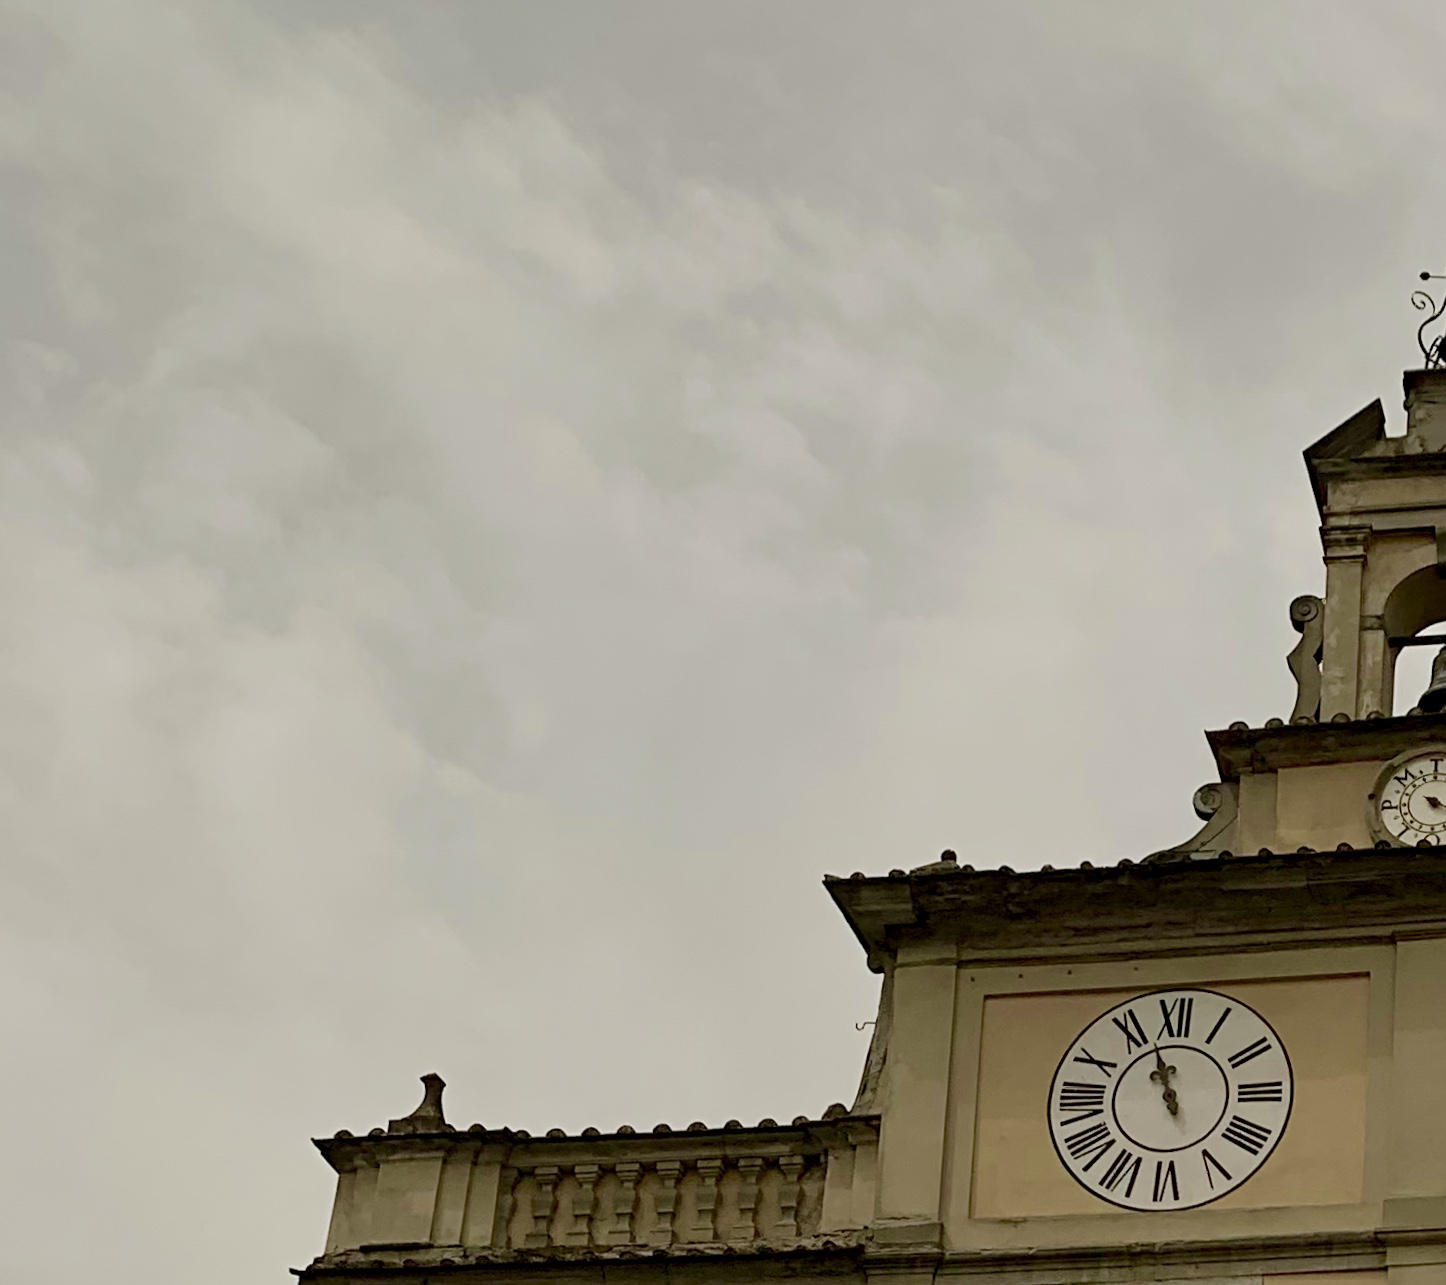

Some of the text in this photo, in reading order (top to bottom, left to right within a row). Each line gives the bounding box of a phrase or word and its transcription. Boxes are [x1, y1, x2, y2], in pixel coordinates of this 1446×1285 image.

[1393, 768, 1417, 787] M
[1430, 758, 1443, 772] T
[1381, 799, 1398, 811] P
[1112, 1009, 1148, 1055] XI
[1157, 998, 1194, 1041] XII
[1205, 1007, 1232, 1044] I
[1073, 1047, 1117, 1077] X
[1228, 1037, 1272, 1069] II
[1238, 1081, 1282, 1102] III
[1221, 1115, 1272, 1155] IIII
[1099, 1149, 1143, 1198] VII
[1153, 1160, 1179, 1202] VI
[1202, 1149, 1232, 1190] V
